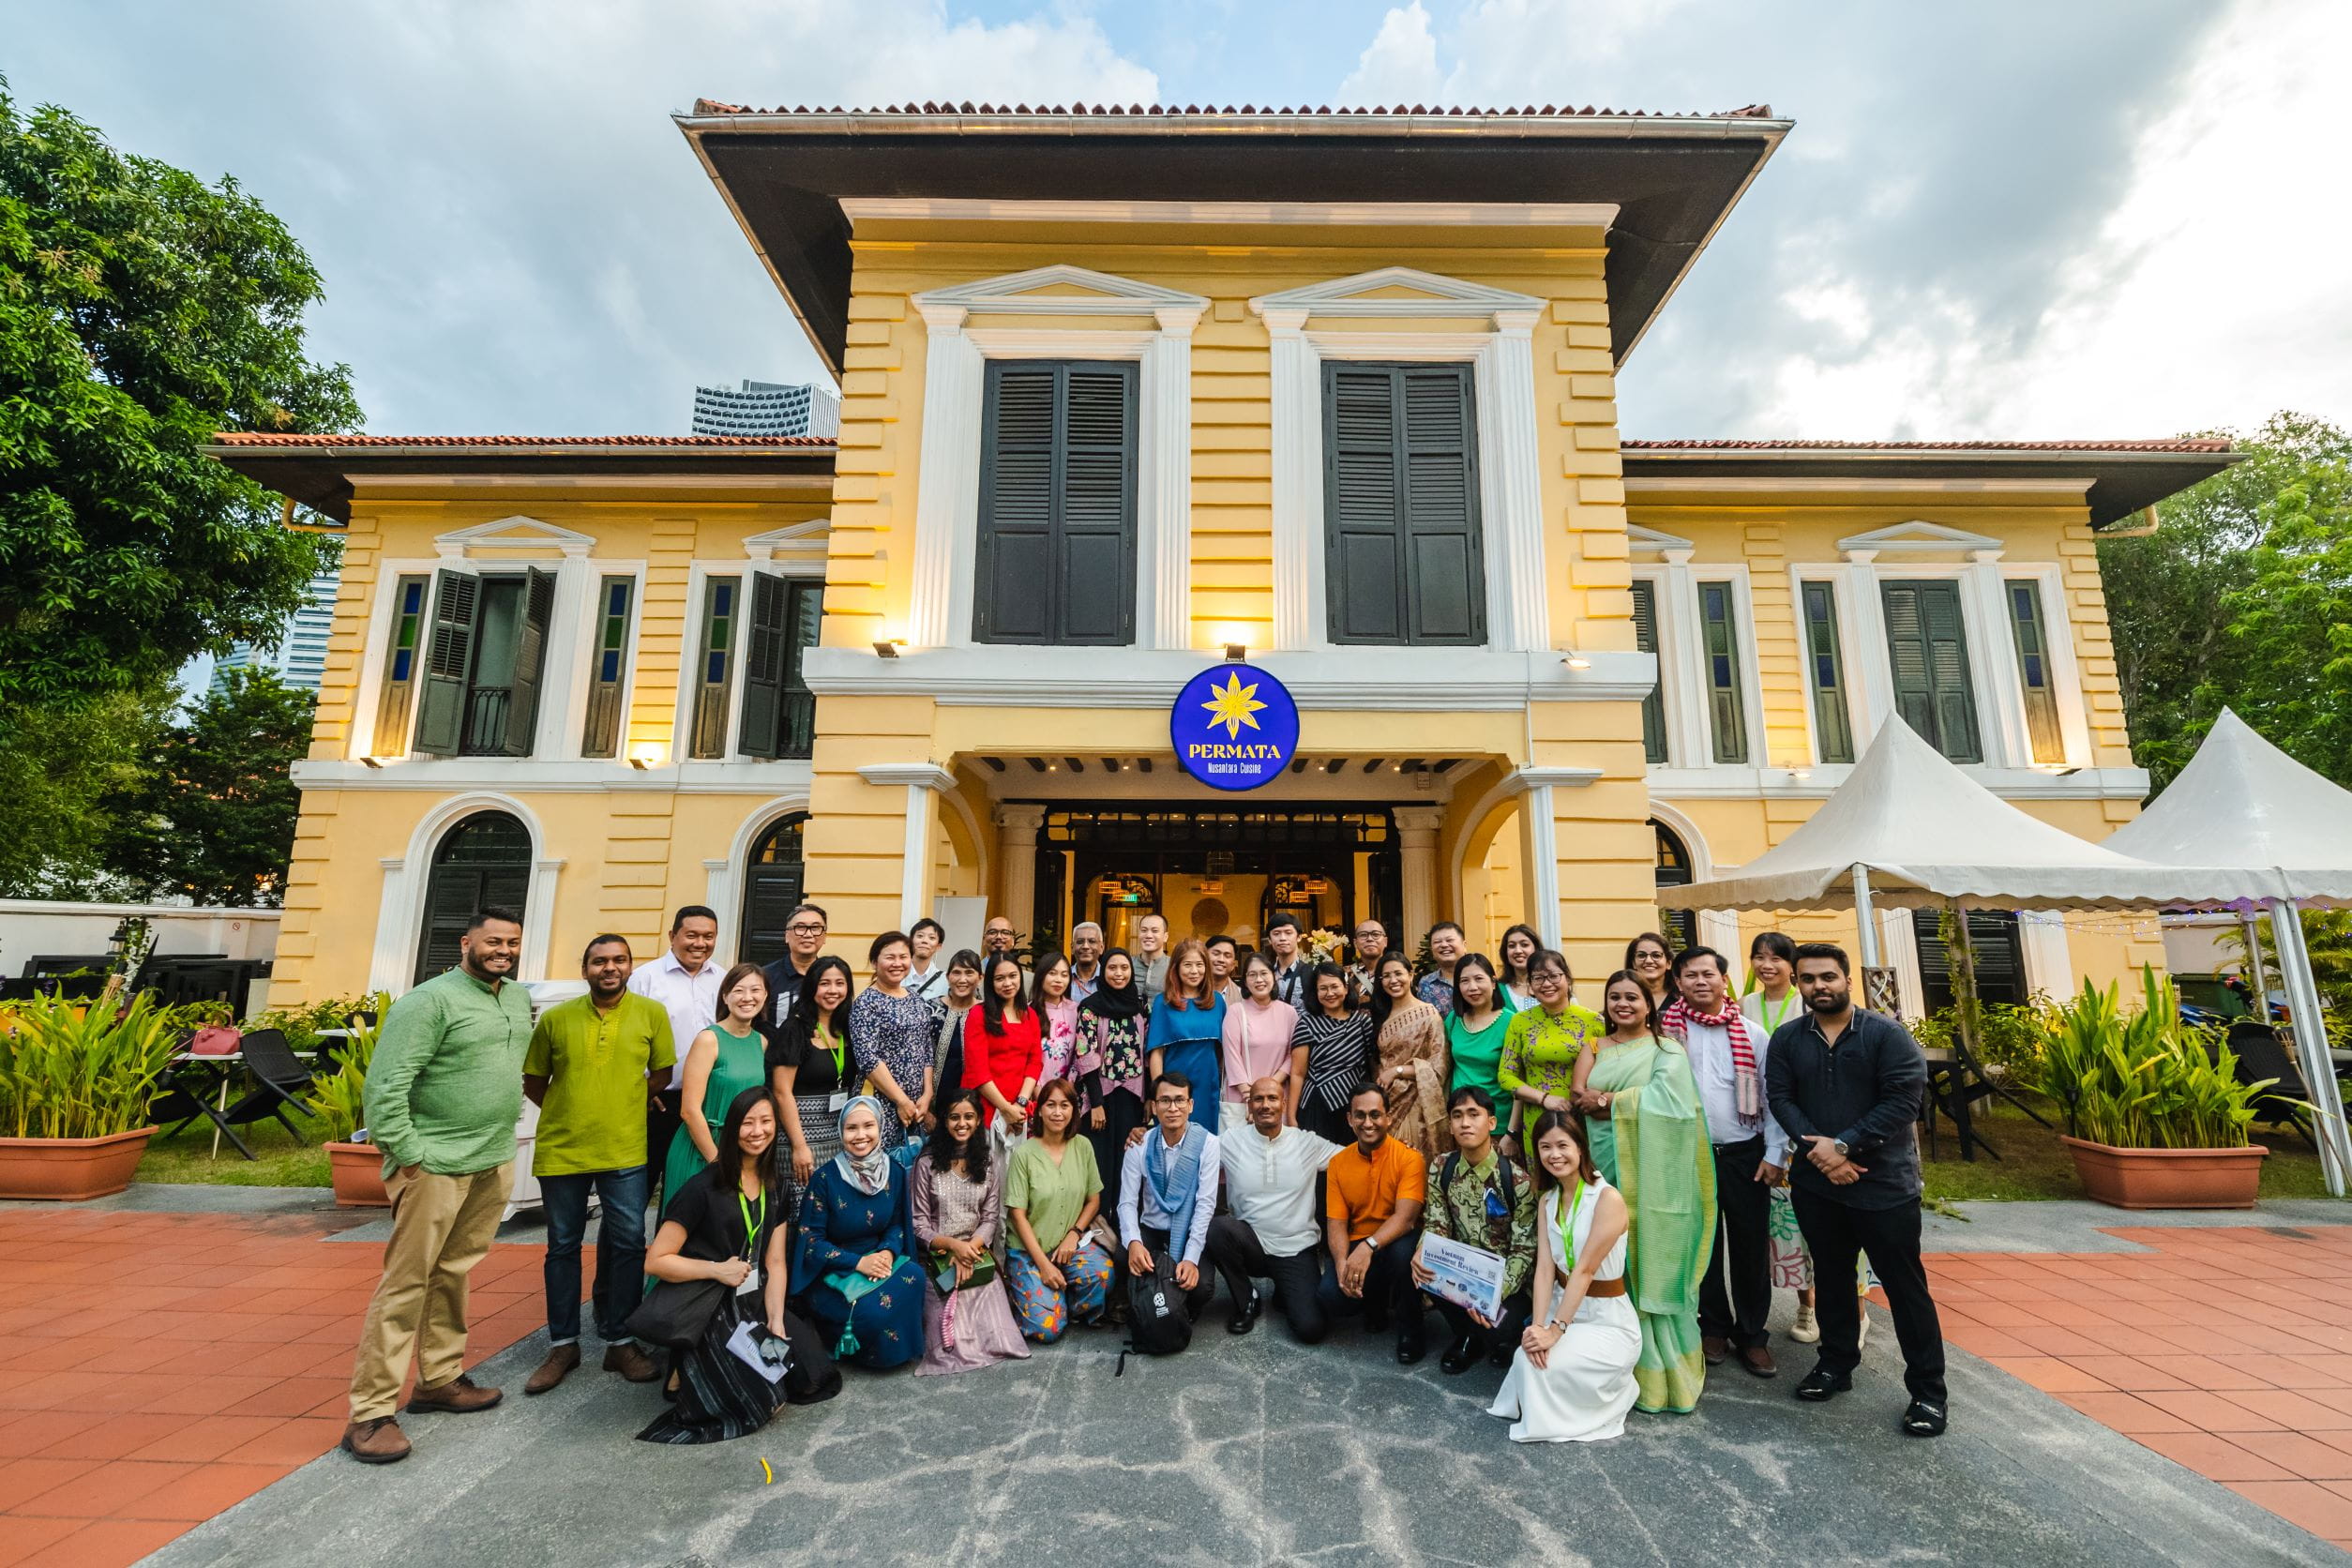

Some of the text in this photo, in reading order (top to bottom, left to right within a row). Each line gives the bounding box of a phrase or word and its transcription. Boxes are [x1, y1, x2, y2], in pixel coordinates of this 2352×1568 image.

[1189, 744, 1281, 759] PERMATA
[1208, 762, 1261, 774] Nusantara Cuisine
[1441, 1248, 1465, 1261] Vietnam
[1425, 1249, 1479, 1275] Investment Review
